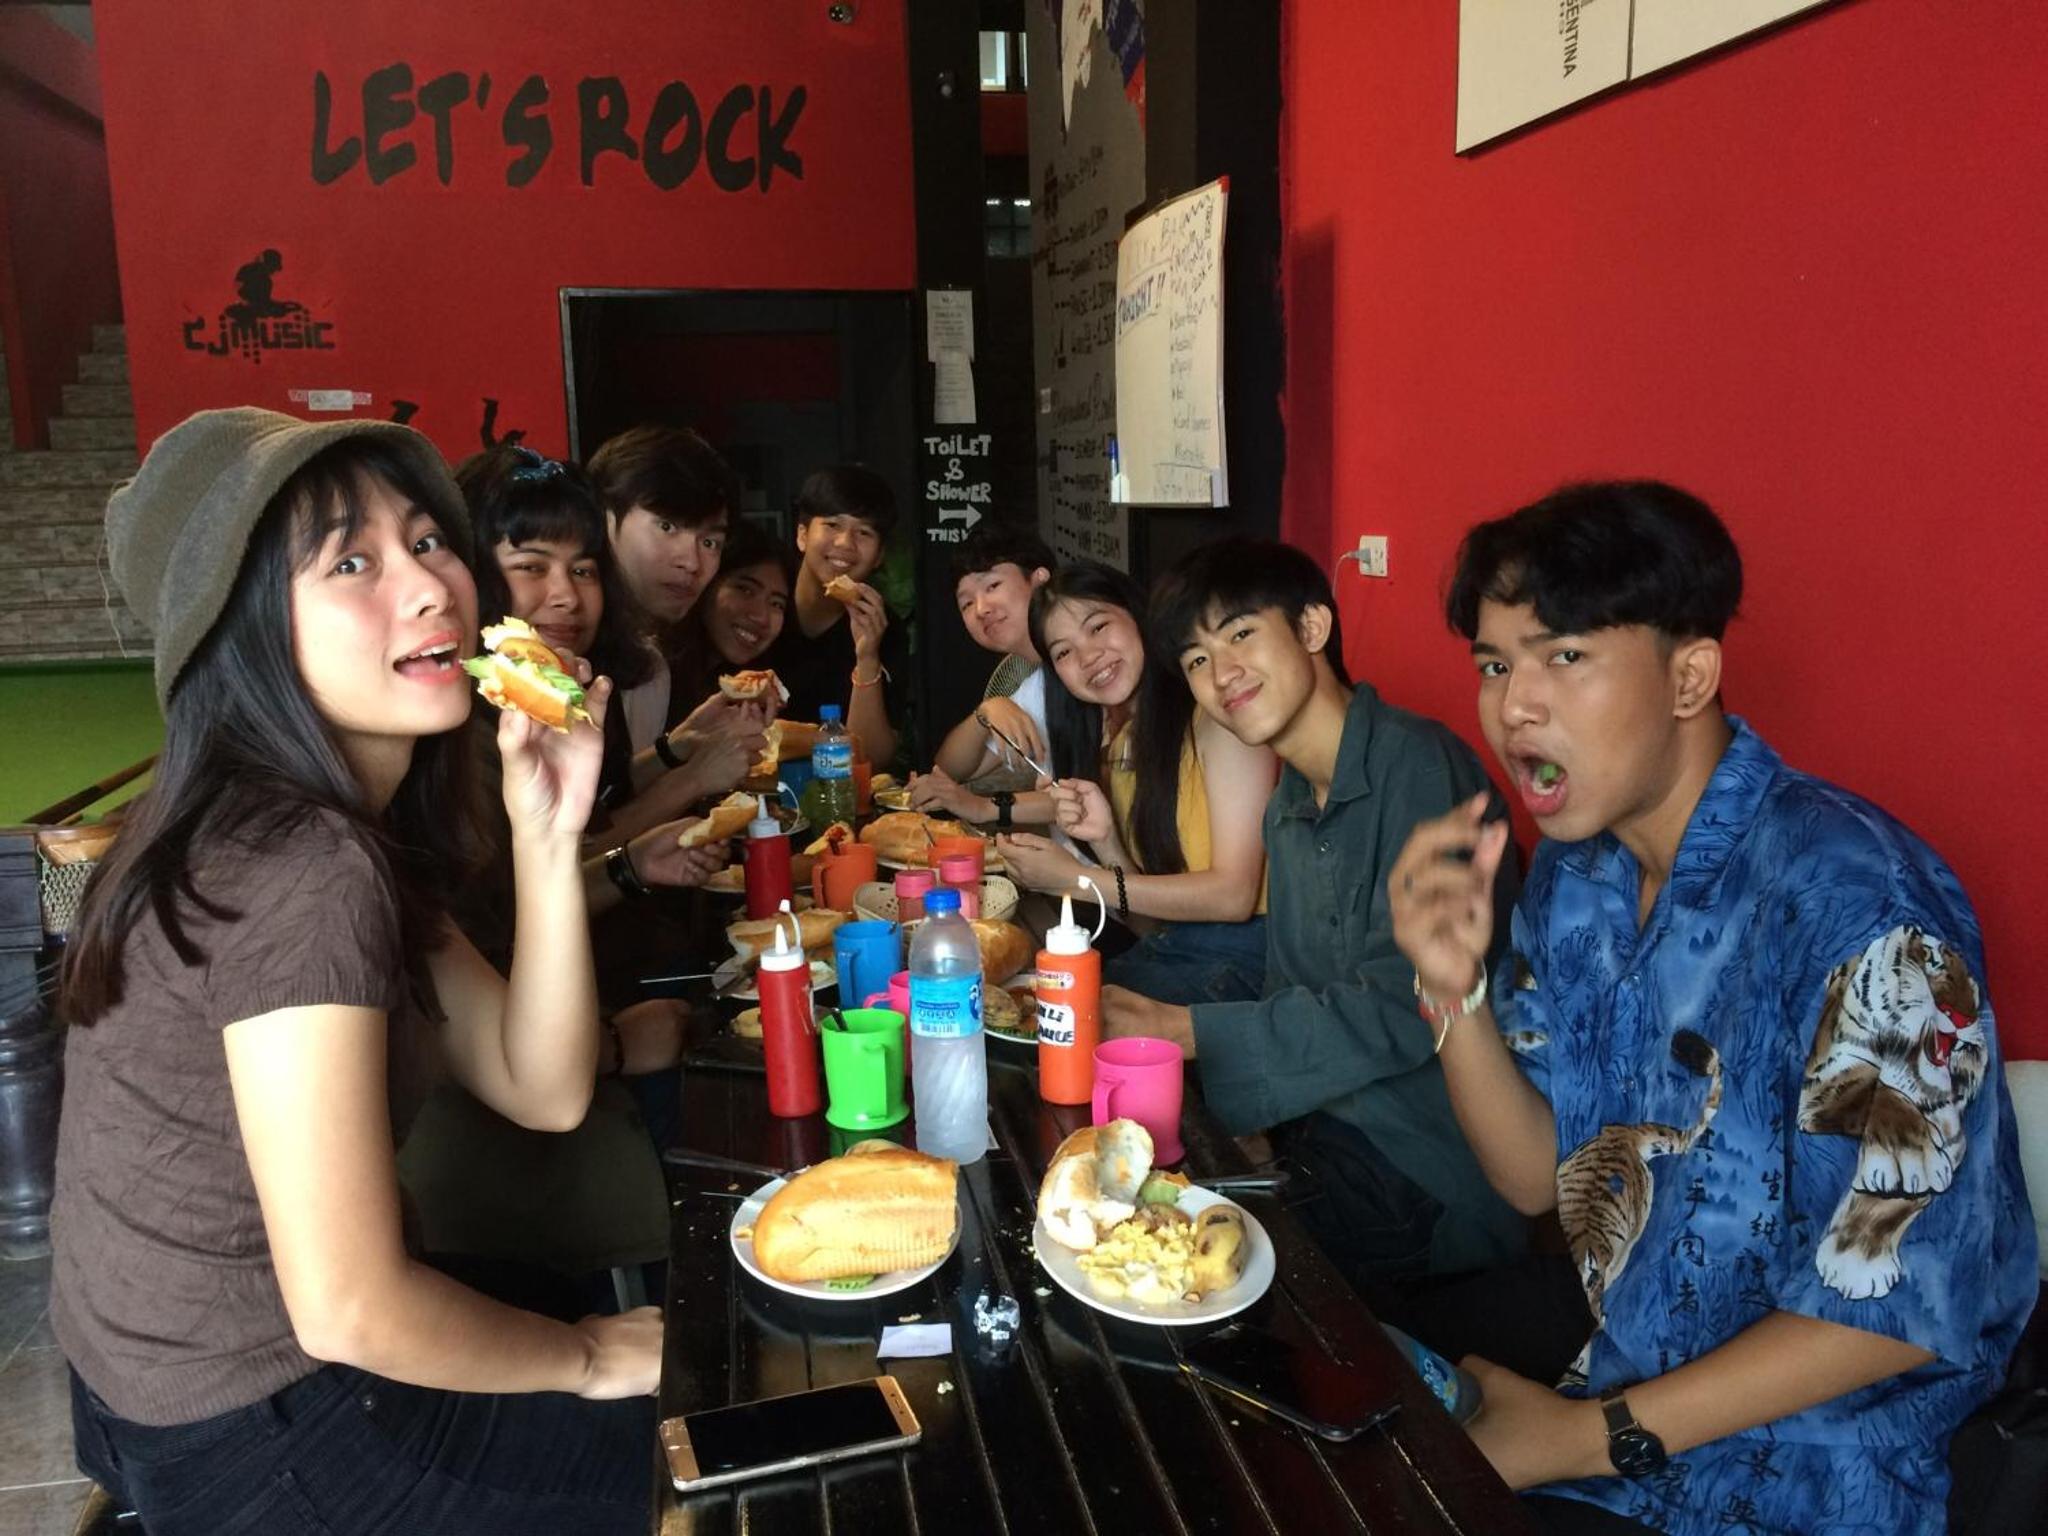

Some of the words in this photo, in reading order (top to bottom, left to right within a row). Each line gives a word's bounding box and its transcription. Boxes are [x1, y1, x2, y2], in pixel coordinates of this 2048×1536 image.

[310, 61, 552, 188] LET'S
[577, 75, 807, 193] ROCK
[943, 457, 965, 482] &
[925, 480, 992, 504] SHOWER
